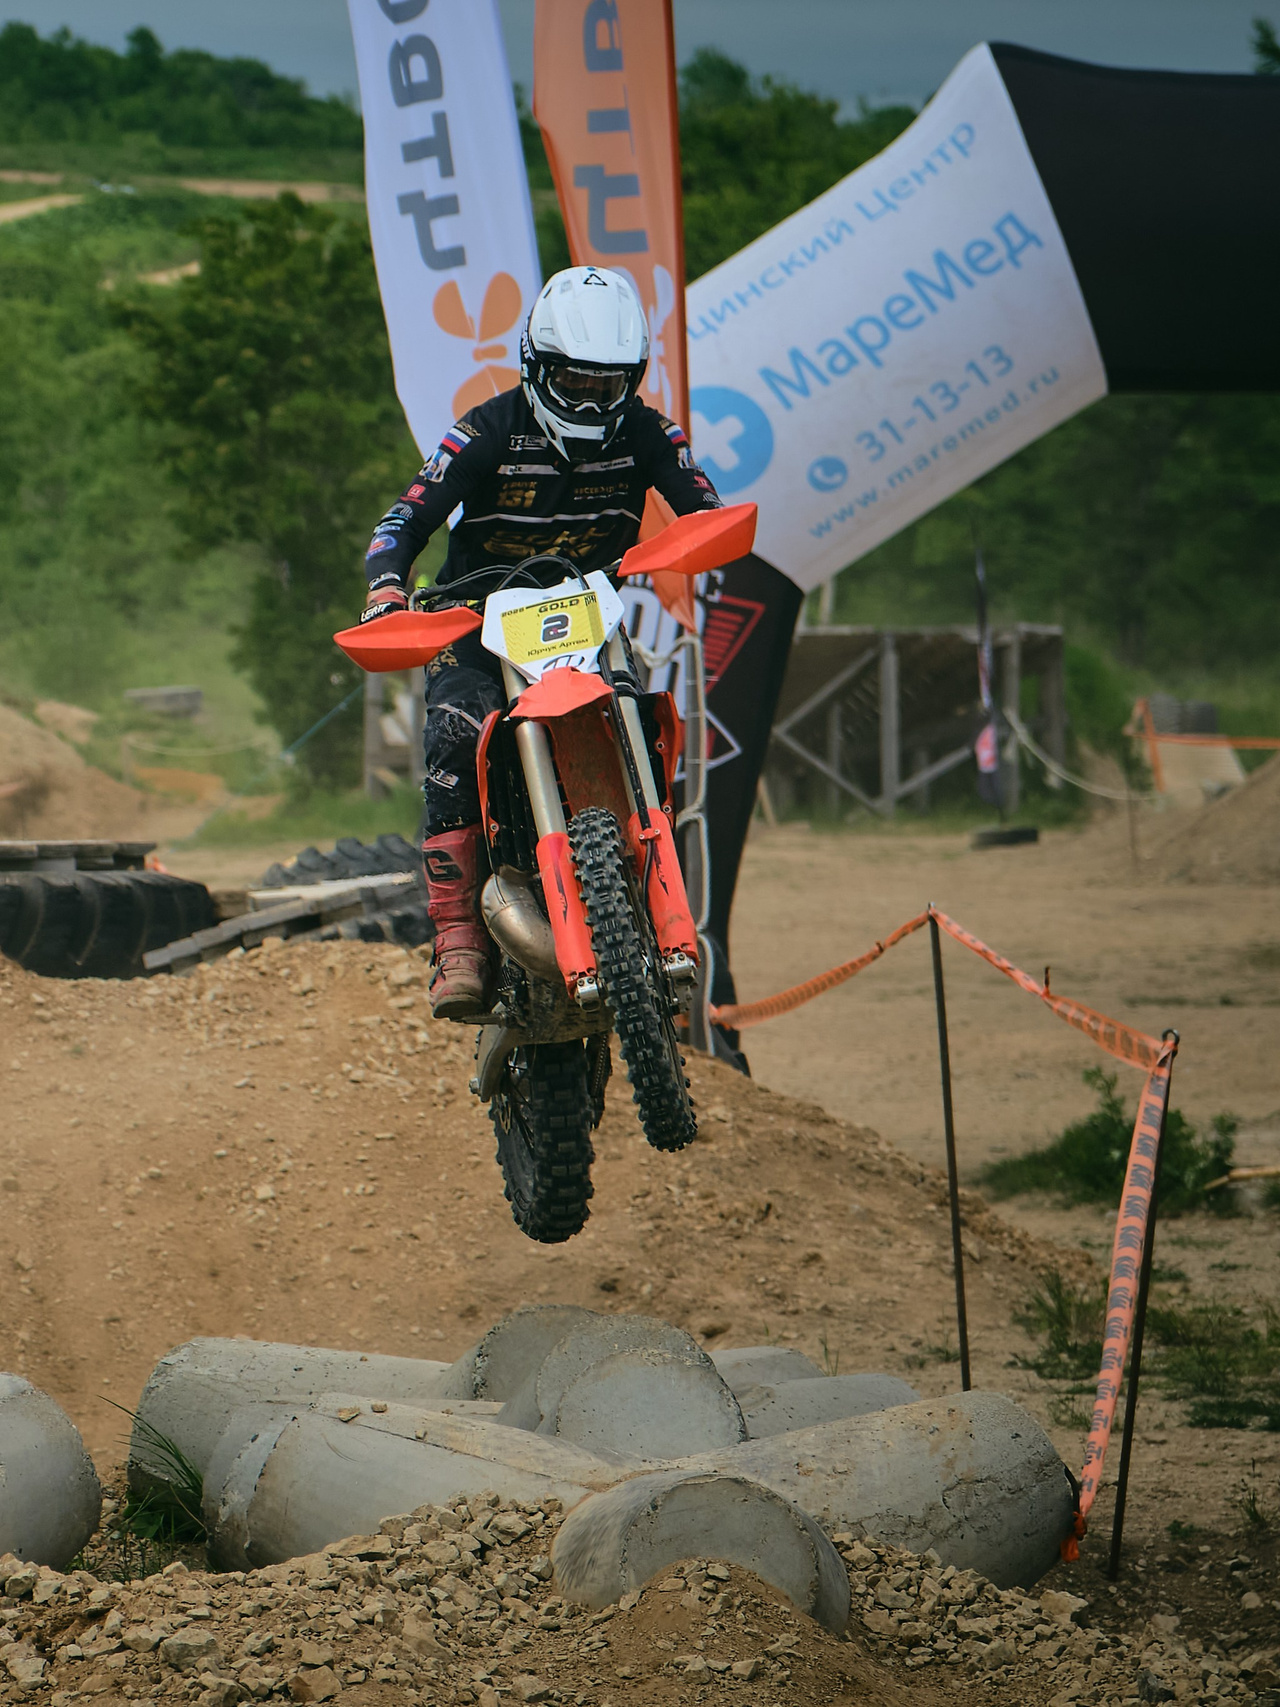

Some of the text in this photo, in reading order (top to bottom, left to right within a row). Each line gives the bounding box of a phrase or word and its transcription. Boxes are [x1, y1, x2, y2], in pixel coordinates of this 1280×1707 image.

[854, 121, 976, 221] Центр
[758, 211, 1044, 411] МареМед
[809, 366, 1060, 538] www.maremed.ru
[855, 344, 1014, 463] 31-13-13
[538, 599, 580, 613] GOLD
[541, 614, 569, 642] 2
